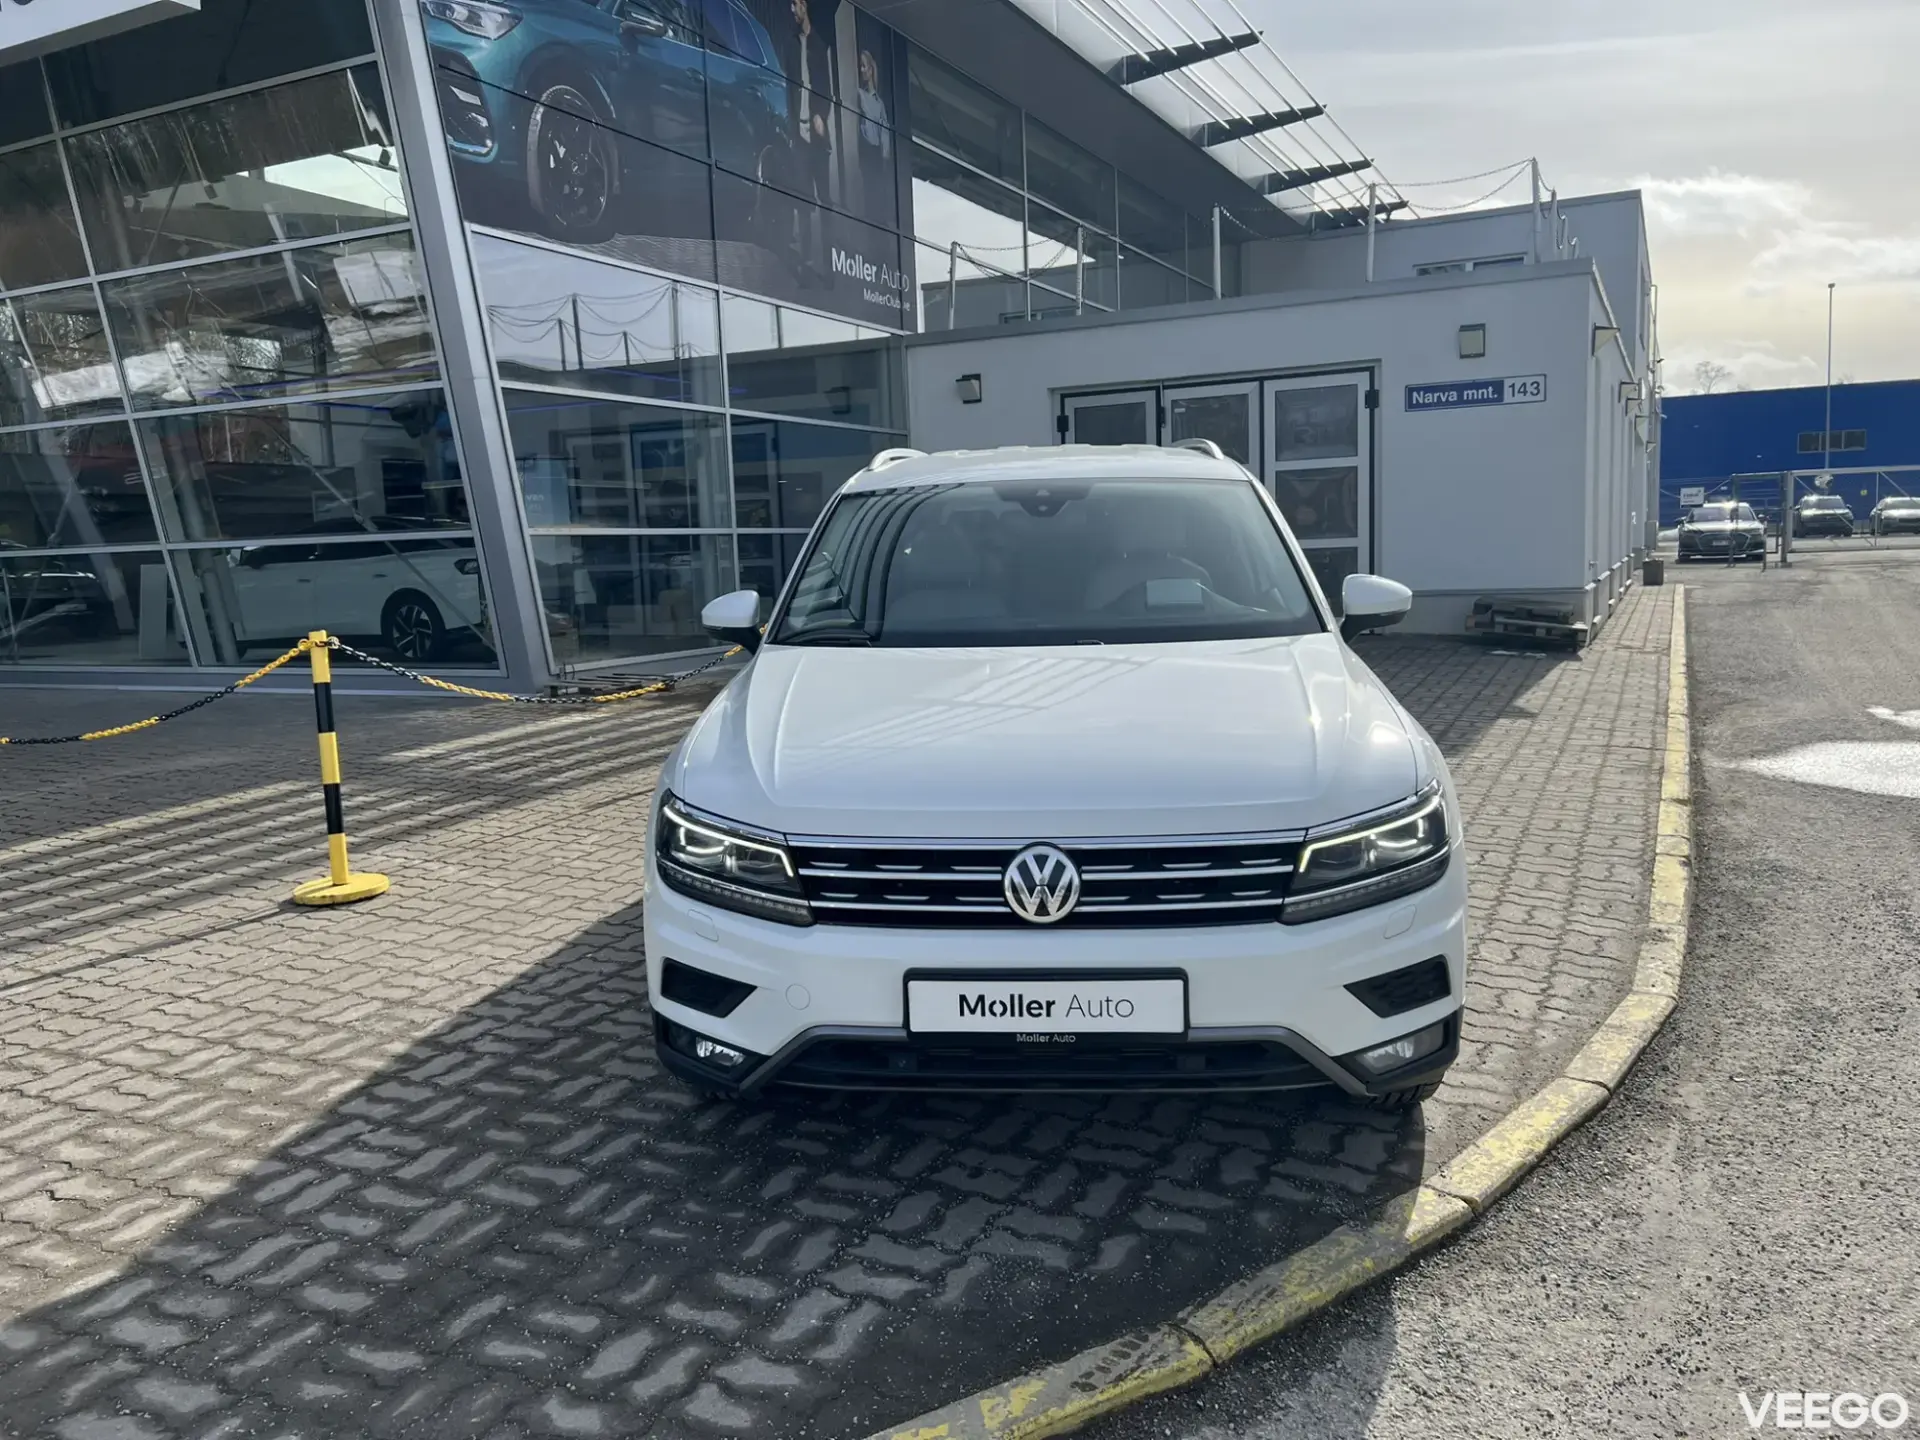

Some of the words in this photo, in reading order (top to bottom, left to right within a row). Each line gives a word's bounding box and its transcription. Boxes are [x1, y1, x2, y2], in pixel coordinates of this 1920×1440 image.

[831, 247, 877, 283] Moller
[880, 263, 910, 292] Auto
[863, 287, 911, 312] MollerClube
[1412, 390, 1457, 404] Narva
[1463, 386, 1498, 400] mnt.
[1508, 381, 1541, 398] 143
[958, 993, 1056, 1018] Moller
[1065, 994, 1135, 1019] Auto
[1016, 1033, 1050, 1043] Moller
[1052, 1033, 1076, 1043] Auto
